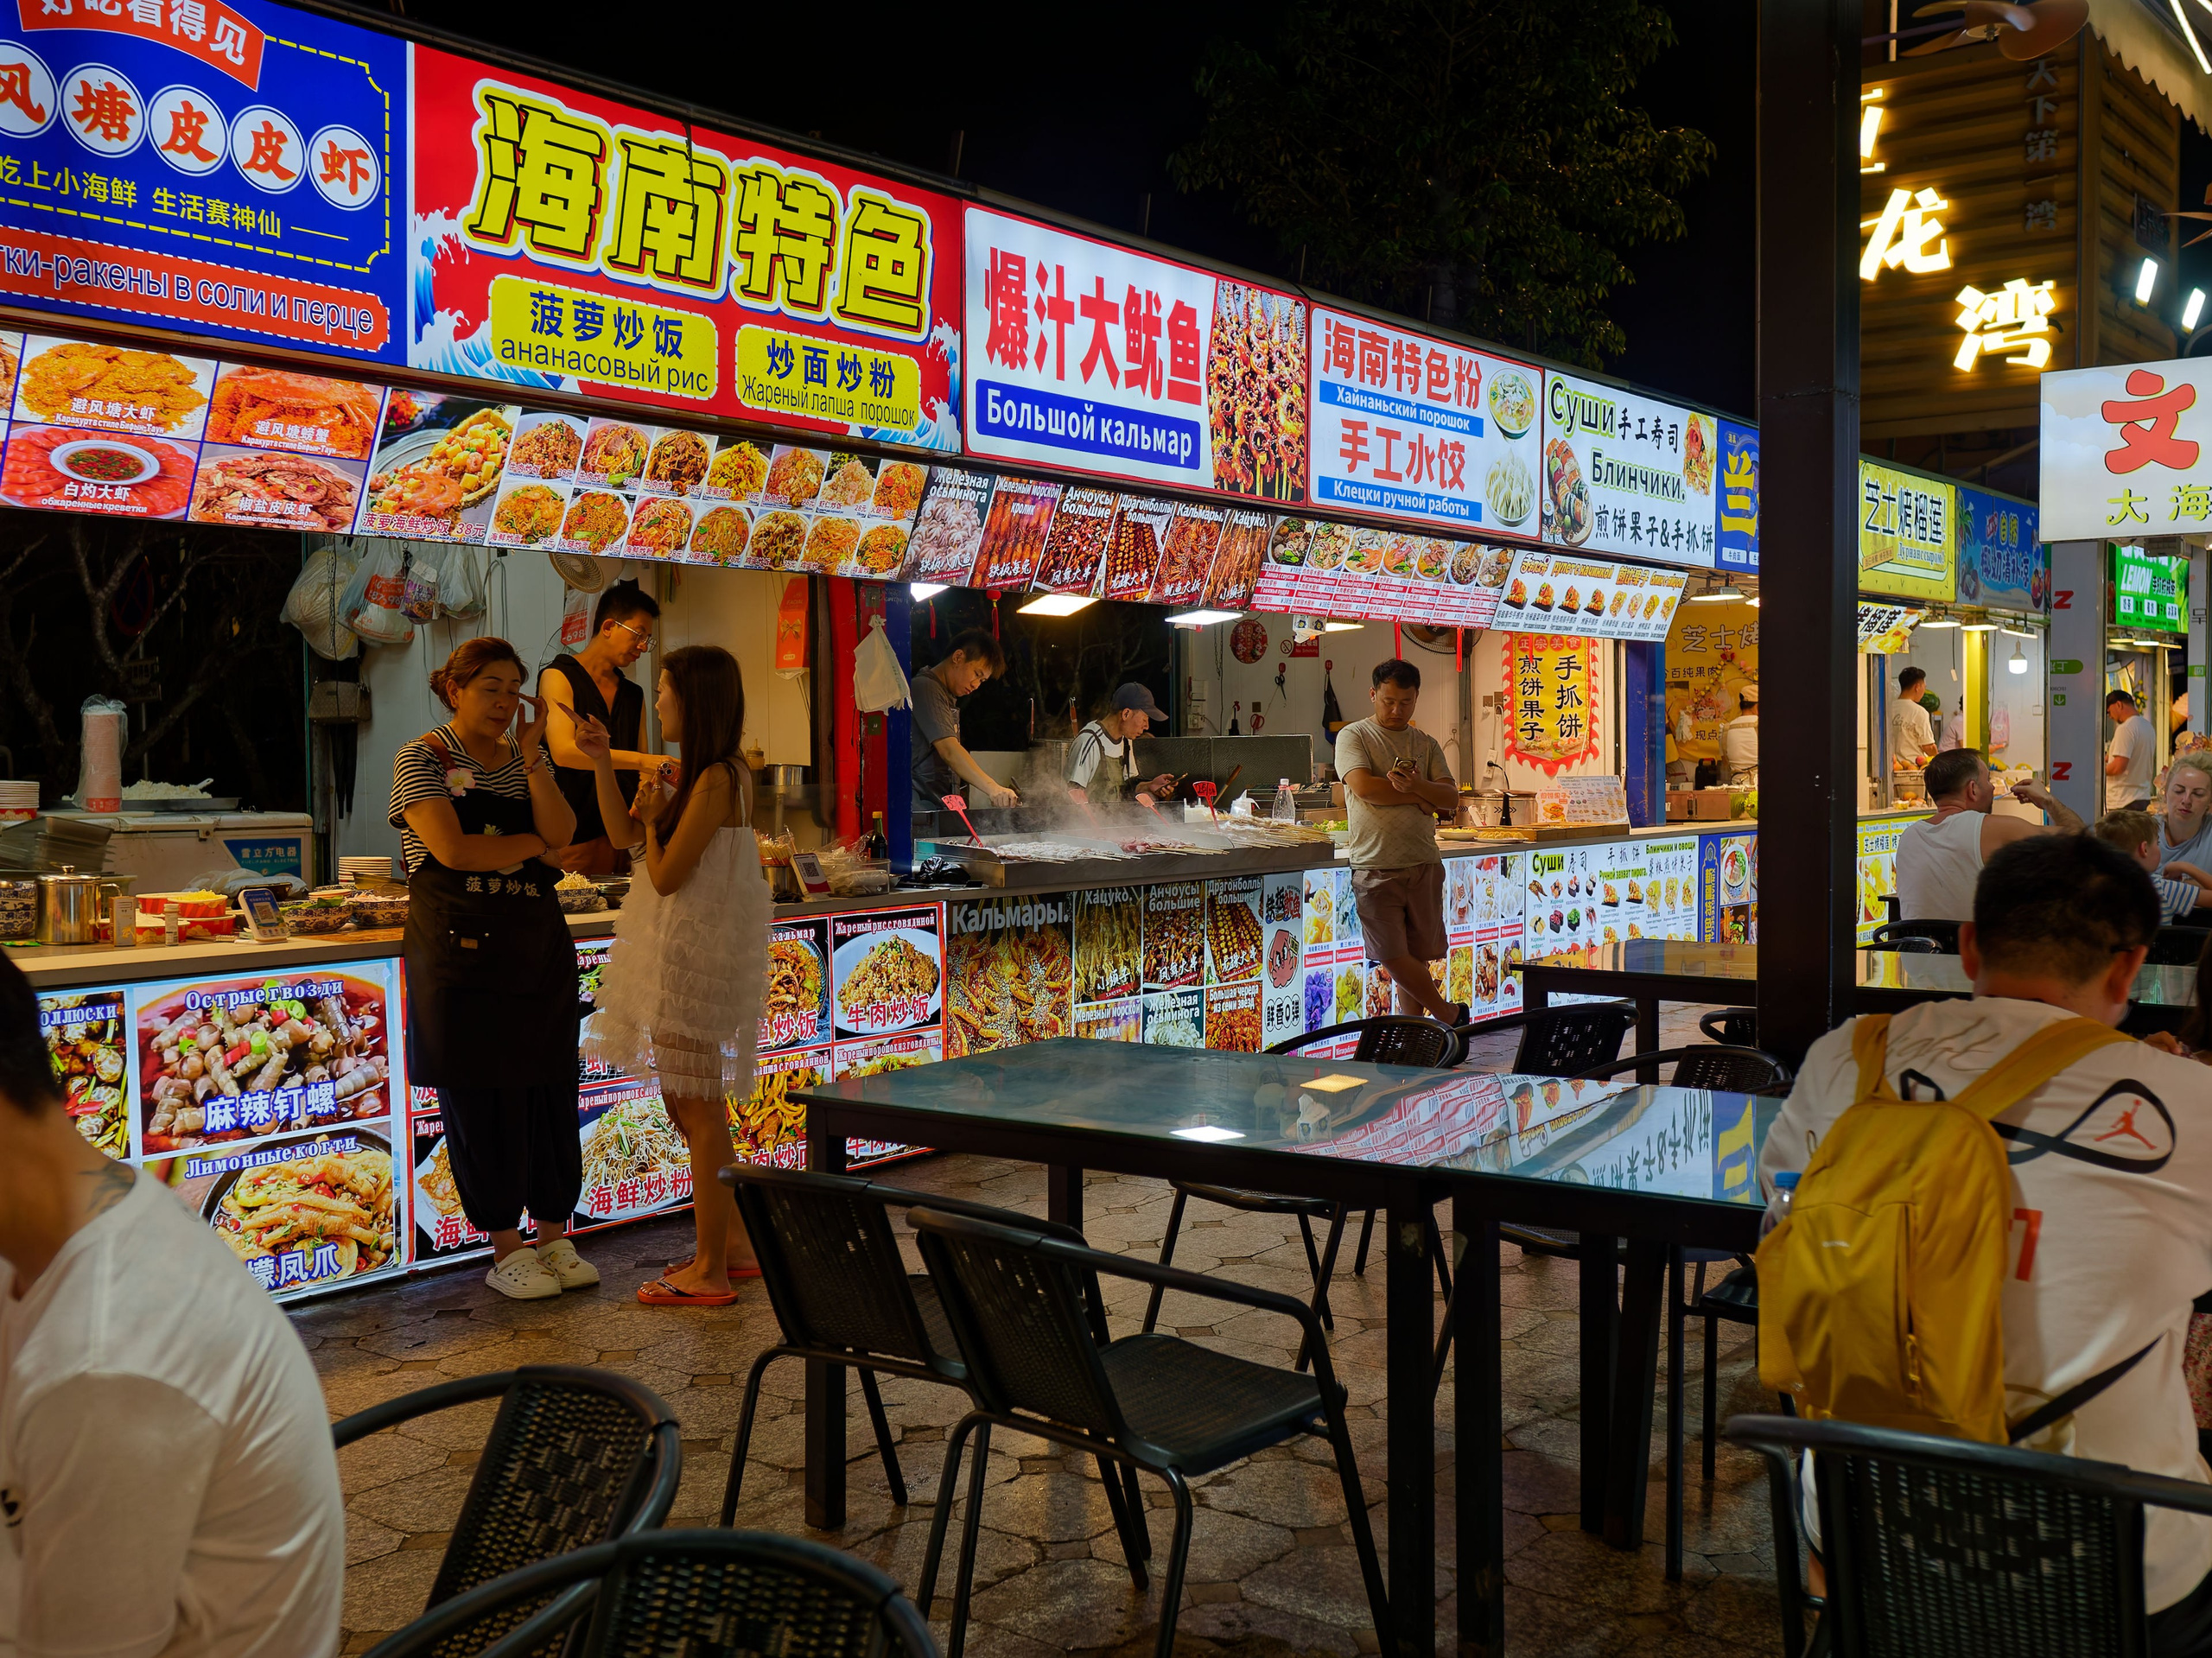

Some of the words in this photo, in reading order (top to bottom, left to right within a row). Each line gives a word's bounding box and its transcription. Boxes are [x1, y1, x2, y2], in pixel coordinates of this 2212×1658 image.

[152, 187, 281, 239] 生活赛神仙
[469, 92, 925, 329] 海南特色
[175, 276, 192, 302] в
[196, 281, 265, 316] соли
[270, 295, 288, 321] и
[292, 296, 375, 340] перце
[531, 290, 684, 360] 菠萝炒饭
[984, 246, 1203, 406] 爆汁大鱿鱼
[500, 338, 661, 389] ананасовый
[667, 367, 709, 395] рис
[766, 339, 895, 400] 炒面炒粉
[1323, 317, 1483, 410] 海南特色粉
[71, 397, 156, 421] 避风塘大虾
[742, 375, 809, 410] Жареный
[811, 390, 854, 419] лапша
[861, 400, 915, 429] порошок
[1337, 385, 1418, 420] Хайнаньский
[1420, 407, 1471, 432] порошок
[1551, 382, 1614, 433] Суши
[255, 420, 330, 443] 避风塘螃蟹
[987, 388, 1096, 442] Большой
[1100, 416, 1192, 464] кальмар
[1618, 407, 1679, 454] 手工寿司
[1339, 418, 1466, 492] 手工水饺
[64, 481, 131, 502] 白灼大虾
[935, 468, 989, 490] Железная
[996, 476, 1033, 496] Железный
[1032, 482, 1061, 500] морской
[1592, 451, 1686, 502] Блинчики.
[238, 497, 313, 518] 椒盐皮皮虾
[929, 484, 988, 504] осьминога
[1010, 501, 1036, 517] кролик
[1062, 500, 1111, 519] большие
[1065, 486, 1114, 506] Анчоусы
[1333, 482, 1381, 506] Клецки
[1383, 490, 1426, 511] ручной
[1428, 498, 1470, 518] работы
[1720, 450, 1758, 537] 兰
[362, 511, 451, 535] 菠萝海鲜炒饭
[456, 522, 486, 537] 38元
[1595, 505, 1713, 556] 煎饼果子&手抓饼
[2120, 563, 2153, 595] LEMON
[1518, 636, 1581, 650] 正宗美食
[1518, 654, 1545, 741] 煎饼果子
[1554, 654, 1583, 740] 手抓饼
[1695, 730, 1719, 740] 现点
[1533, 854, 1564, 876] Суши
[1568, 851, 1587, 874] 寿司
[466, 876, 541, 899] 菠萝炒饭
[1149, 884, 1200, 899] Анчоусы
[1208, 877, 1263, 896] Драгонболлы
[1217, 892, 1254, 905] большие
[952, 902, 1069, 935] Кальмары.
[1148, 897, 1201, 912] большие
[185, 988, 266, 1012] Острые
[269, 980, 344, 1004] гвозди
[1149, 994, 1198, 1012] Железная
[40, 1003, 118, 1028] оллюски
[846, 994, 931, 1032] 牛肉炒饭
[1075, 1007, 1111, 1024] Железный
[1111, 1001, 1141, 1020] морской
[1147, 1007, 1200, 1025] осьминога
[204, 1081, 337, 1134] 麻辣钉螺
[184, 1147, 292, 1180] Лимонные
[295, 1135, 359, 1161] когти
[588, 1166, 694, 1218] 海鲜炒粉
